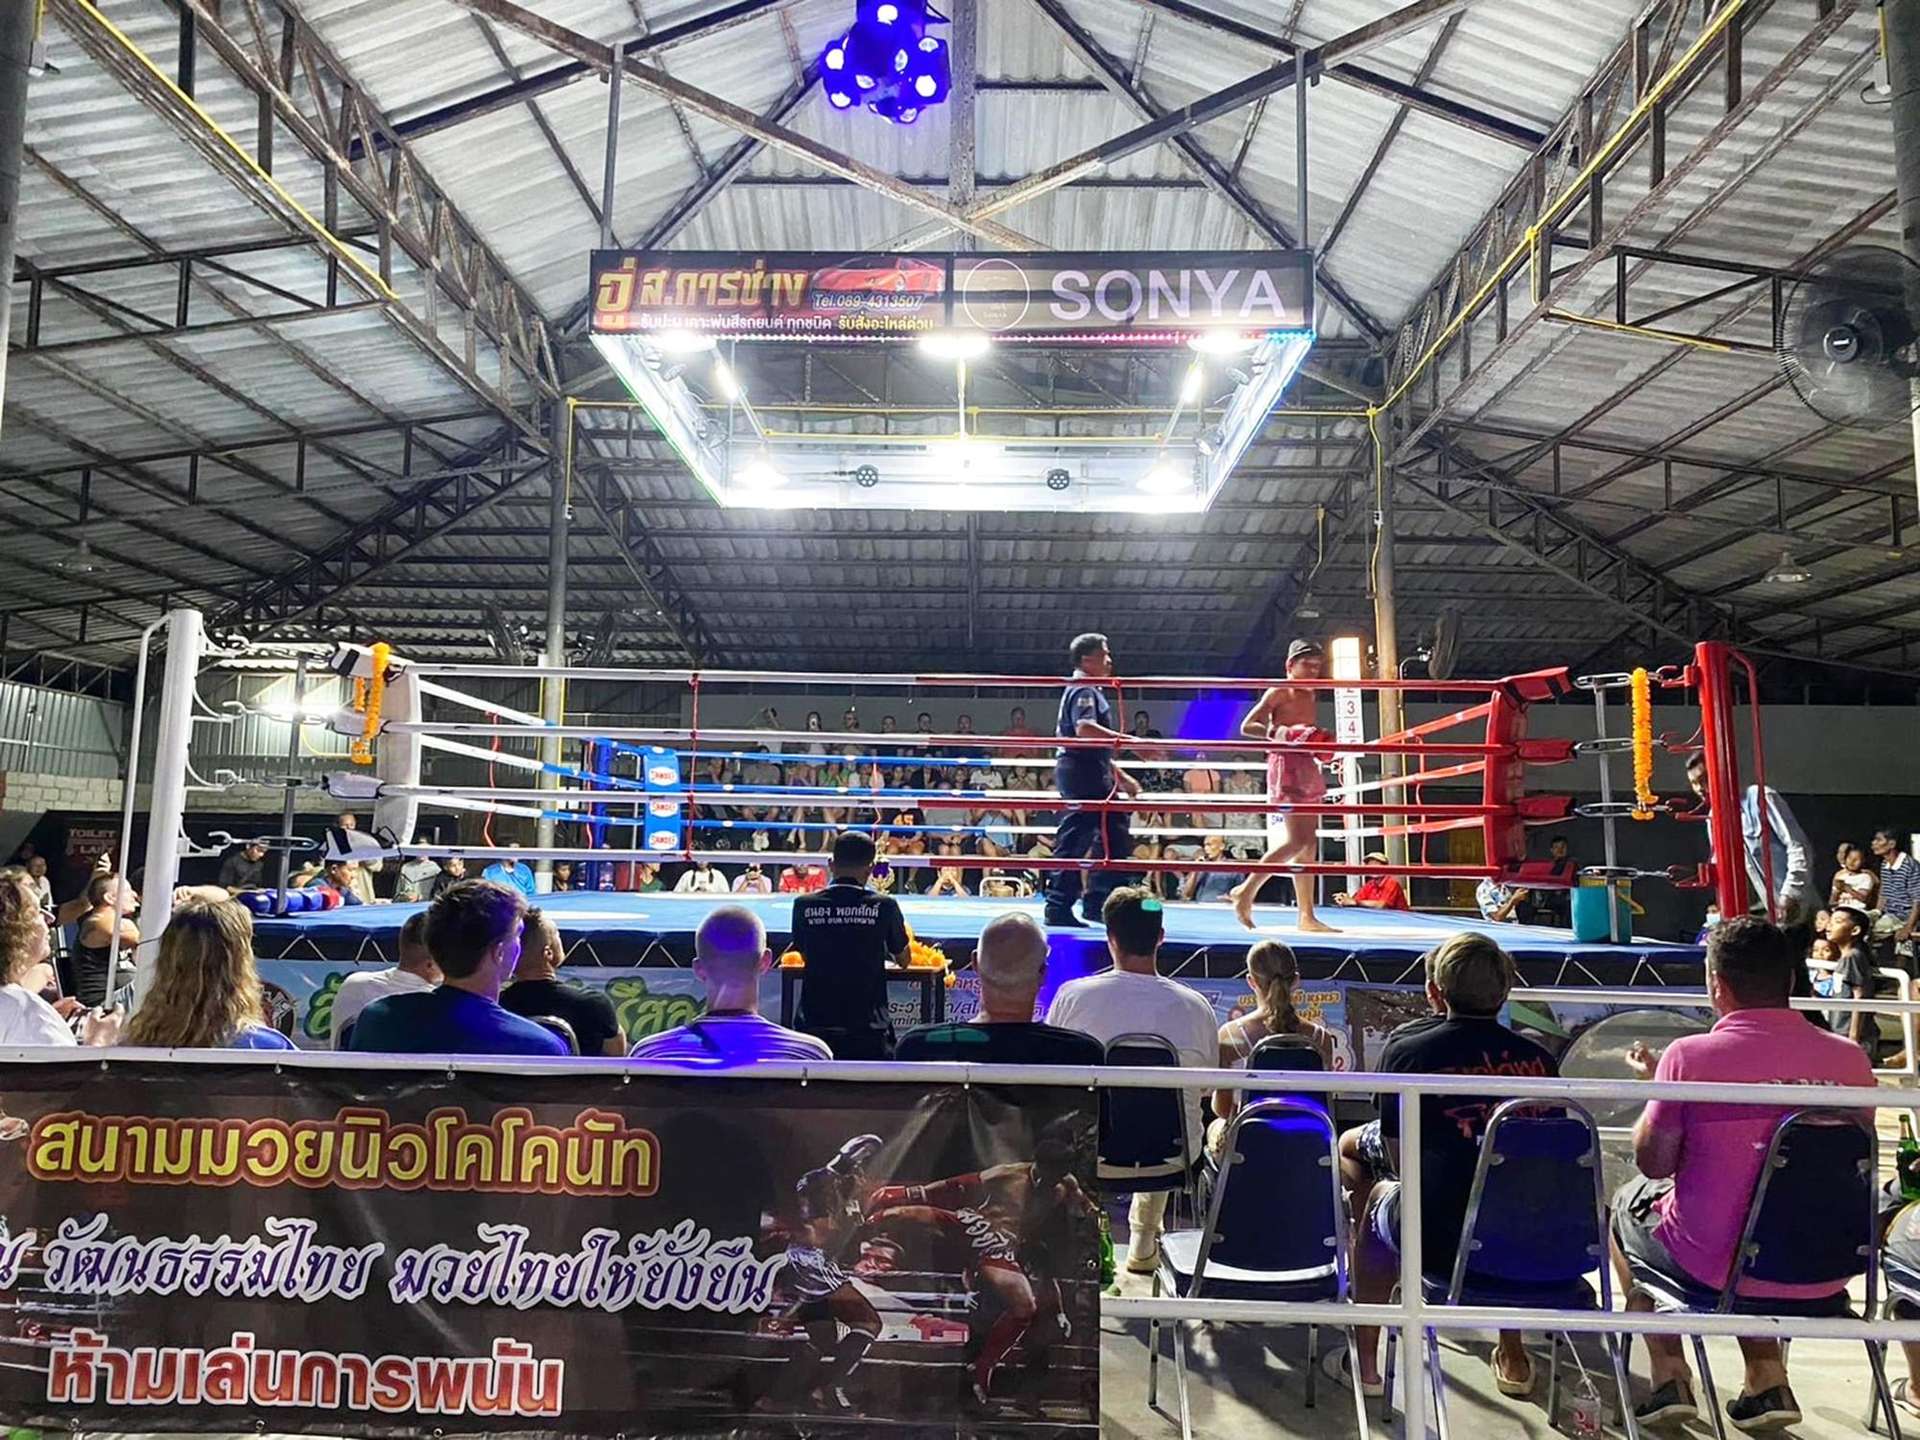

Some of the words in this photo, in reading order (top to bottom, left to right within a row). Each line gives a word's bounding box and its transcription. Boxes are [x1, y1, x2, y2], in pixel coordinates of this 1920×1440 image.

[640, 258, 808, 306] ส.การช่าง
[1050, 269, 1287, 322] SONYA
[1346, 700, 1356, 715] 3
[31, 1109, 658, 1194] สนามมวยนิวโคโคนัท
[44, 1214, 384, 1300] วัฒนธรรมไทย
[390, 1219, 790, 1313] มวยไทยให้ยั่งยืน
[47, 1329, 564, 1418] ห้ามเล่นการพนัน
